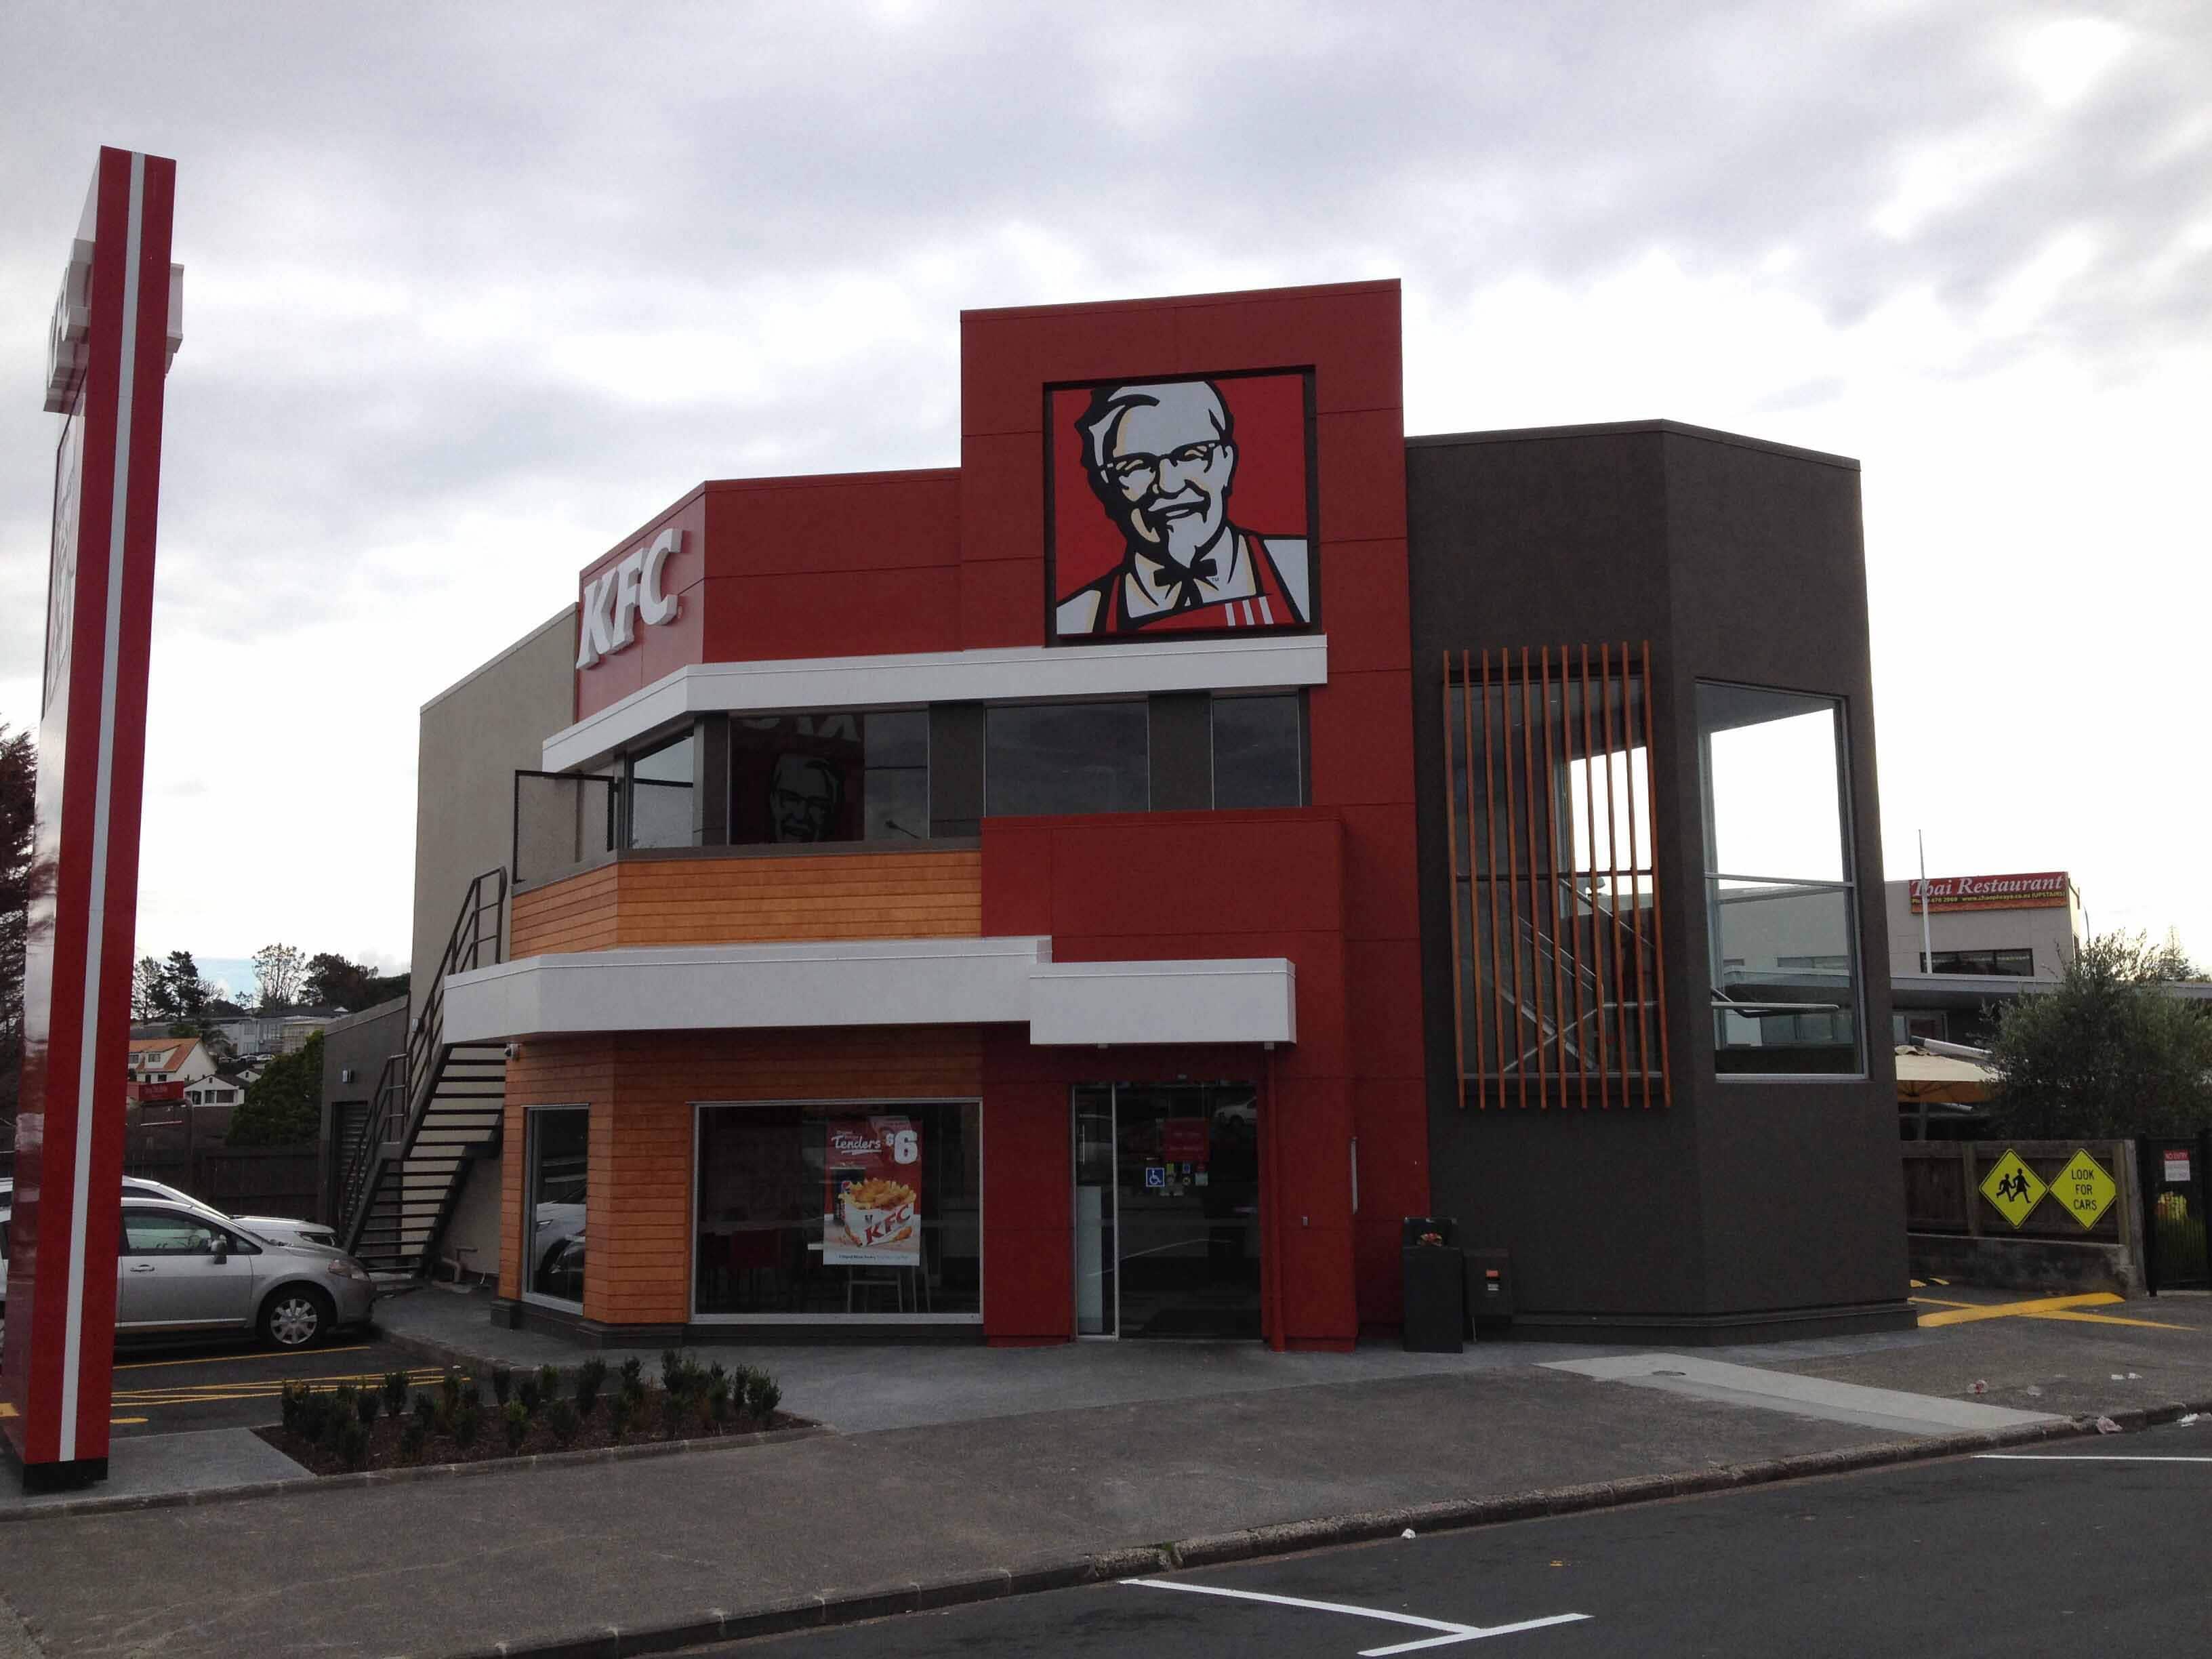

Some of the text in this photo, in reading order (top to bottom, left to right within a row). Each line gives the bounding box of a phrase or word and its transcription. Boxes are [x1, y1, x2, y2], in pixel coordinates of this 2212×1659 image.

[576, 528, 683, 670] KFC
[1957, 876, 2064, 895] Restaurant
[831, 1134, 881, 1150] Tenders
[2071, 1168, 2095, 1181] LOOK
[2075, 1184, 2093, 1195] FOR
[2073, 1199, 2097, 1211] CARS
[863, 1203, 911, 1244] KFC
